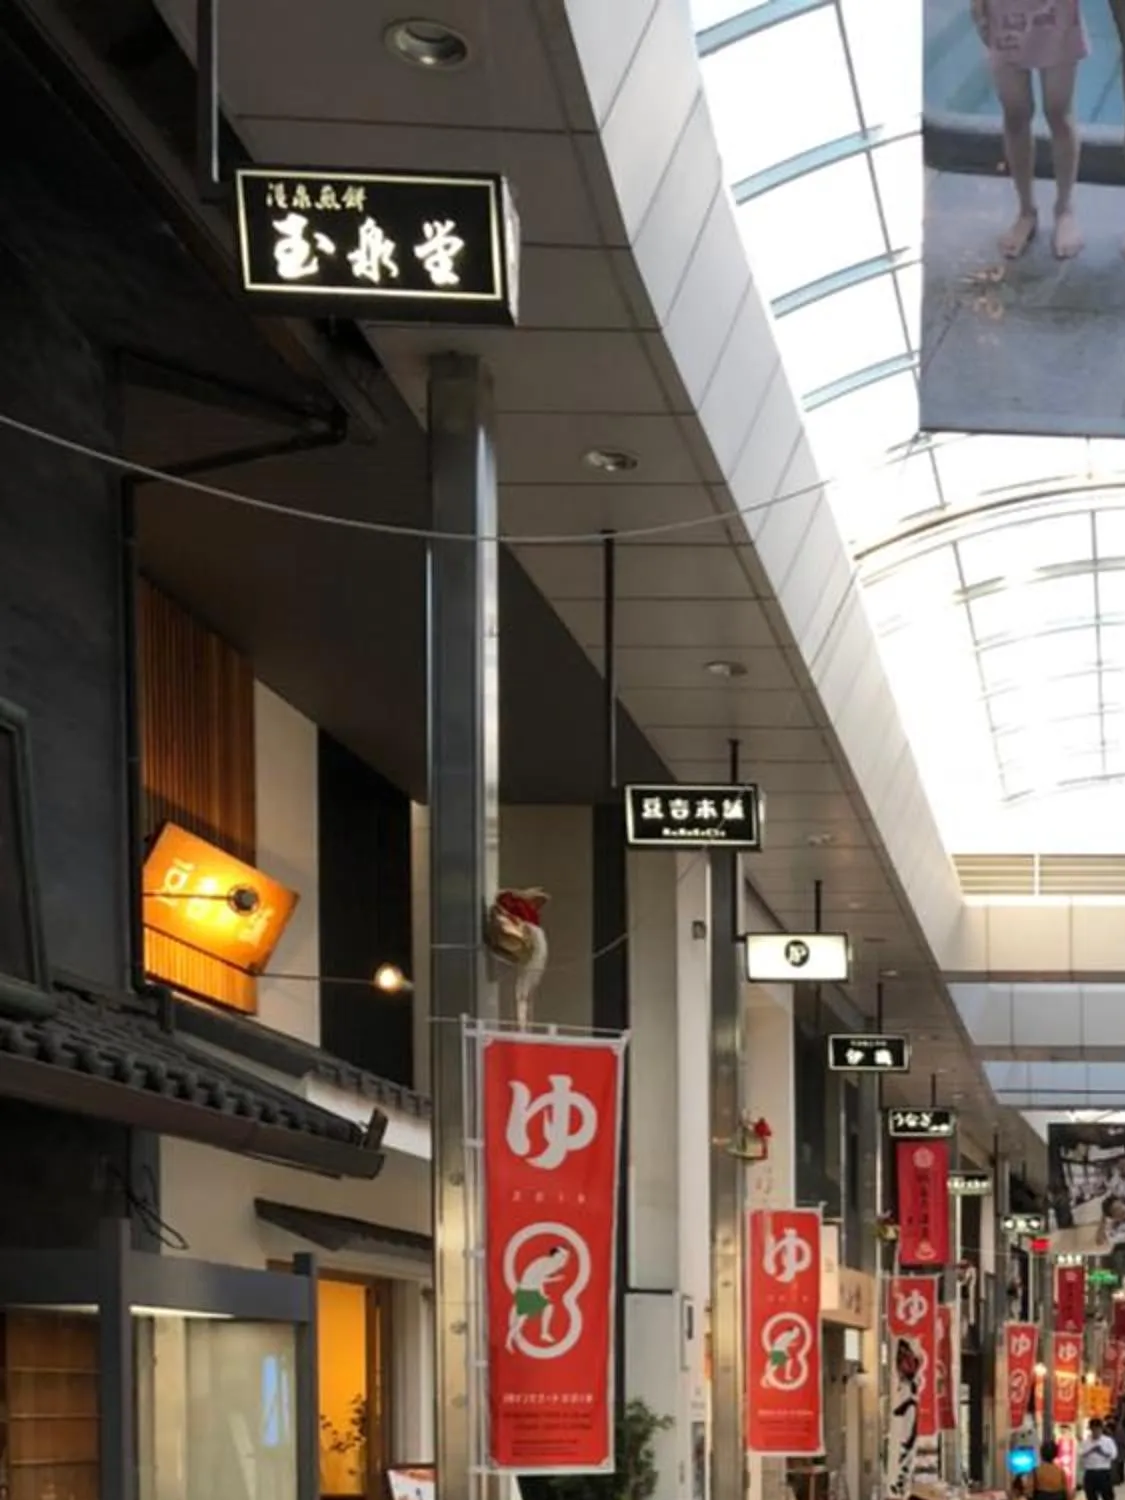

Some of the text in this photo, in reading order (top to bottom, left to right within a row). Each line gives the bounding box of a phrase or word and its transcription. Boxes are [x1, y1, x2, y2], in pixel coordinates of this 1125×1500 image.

[271, 212, 466, 288] 玉泉堂
[505, 1073, 599, 1171] ゆ
[763, 1227, 812, 1283] ゆ
[895, 1287, 929, 1326] ゆ
